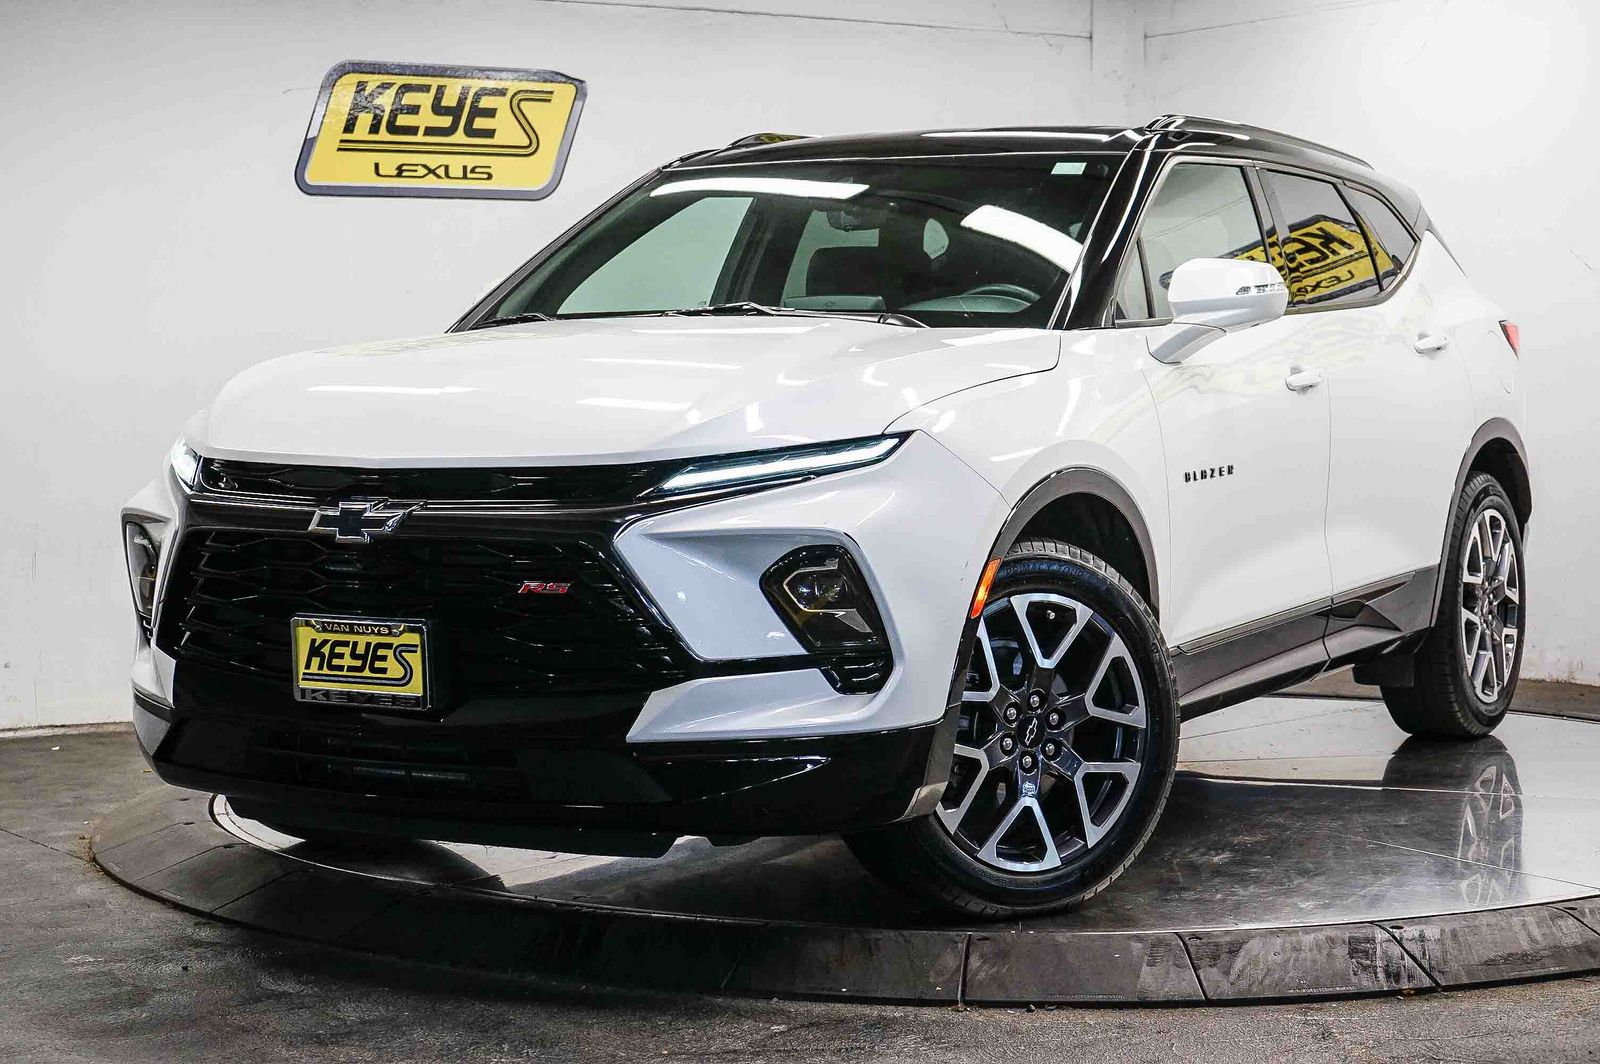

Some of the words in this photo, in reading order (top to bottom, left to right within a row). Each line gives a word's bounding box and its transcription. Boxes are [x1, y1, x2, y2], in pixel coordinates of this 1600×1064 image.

[337, 81, 554, 157] KEYES
[374, 162, 493, 180] LEXUS
[1184, 464, 1234, 483] BLAZER
[517, 581, 571, 594] RS
[324, 622, 350, 632] VAN
[353, 624, 389, 634] NUYS
[301, 638, 419, 688] KEYES
